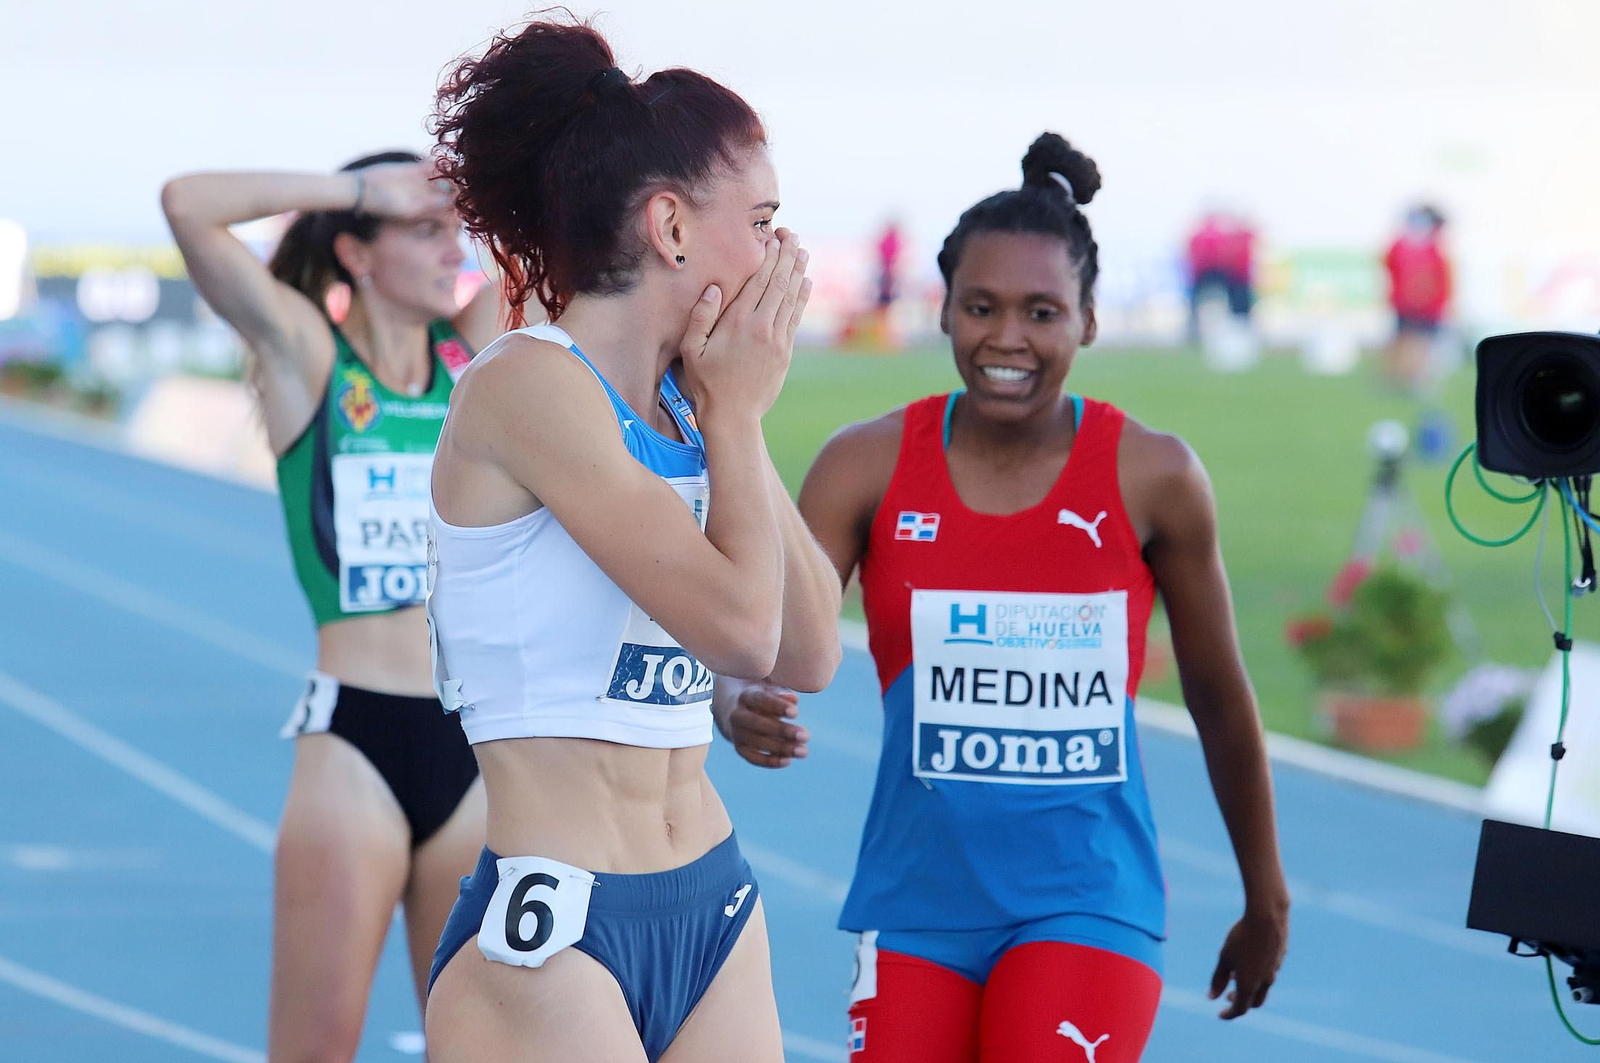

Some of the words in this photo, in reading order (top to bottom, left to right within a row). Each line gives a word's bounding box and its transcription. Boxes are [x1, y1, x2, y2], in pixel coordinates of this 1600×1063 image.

[950, 603, 987, 635] H
[995, 601, 1106, 620] DIPUTACIÓN
[995, 621, 1018, 636] DE
[1028, 622, 1103, 637] HUELVA
[931, 666, 1113, 708] MEDINA
[505, 873, 559, 952] 6
